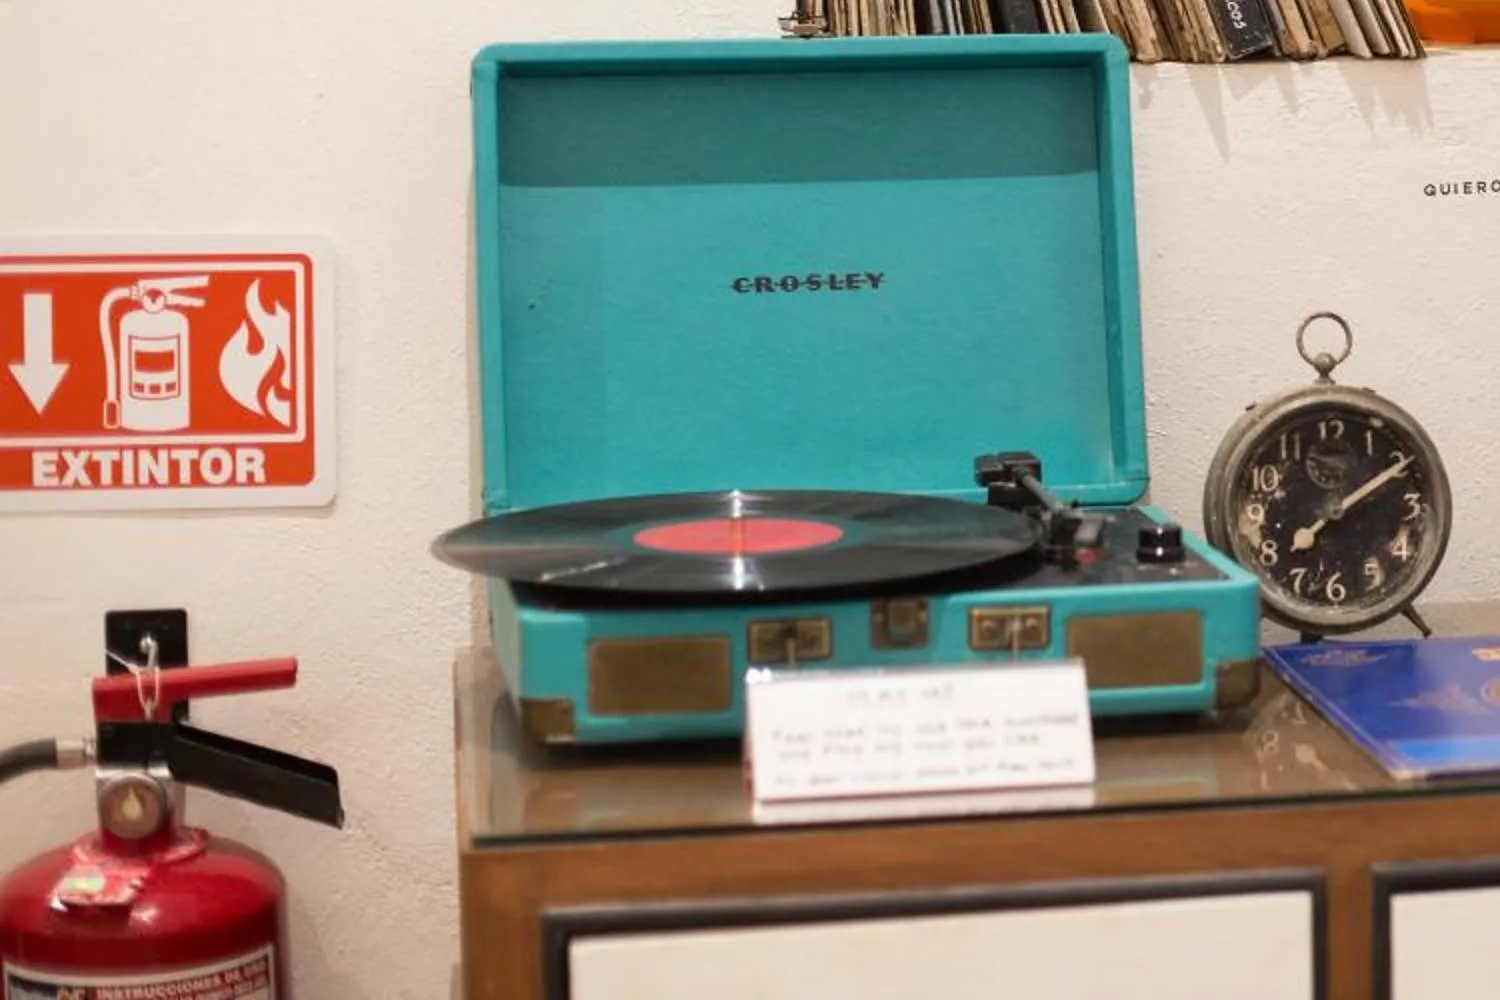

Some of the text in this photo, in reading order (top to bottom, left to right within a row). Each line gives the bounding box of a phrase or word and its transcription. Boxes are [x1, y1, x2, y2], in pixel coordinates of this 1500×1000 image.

[732, 271, 885, 294] CROSLEY
[1317, 420, 1345, 440] 12
[1365, 430, 1374, 456] 1
[1280, 433, 1301, 460] 11
[32, 448, 266, 488] EXTINTOR
[1252, 464, 1279, 491] 10
[1247, 503, 1264, 526] 9
[1403, 493, 1421, 521] 3
[1260, 540, 1278, 566] 8
[1391, 535, 1410, 561] 4
[1290, 567, 1307, 594] 7
[1326, 571, 1346, 601] 6
[1364, 560, 1382, 590] 5
